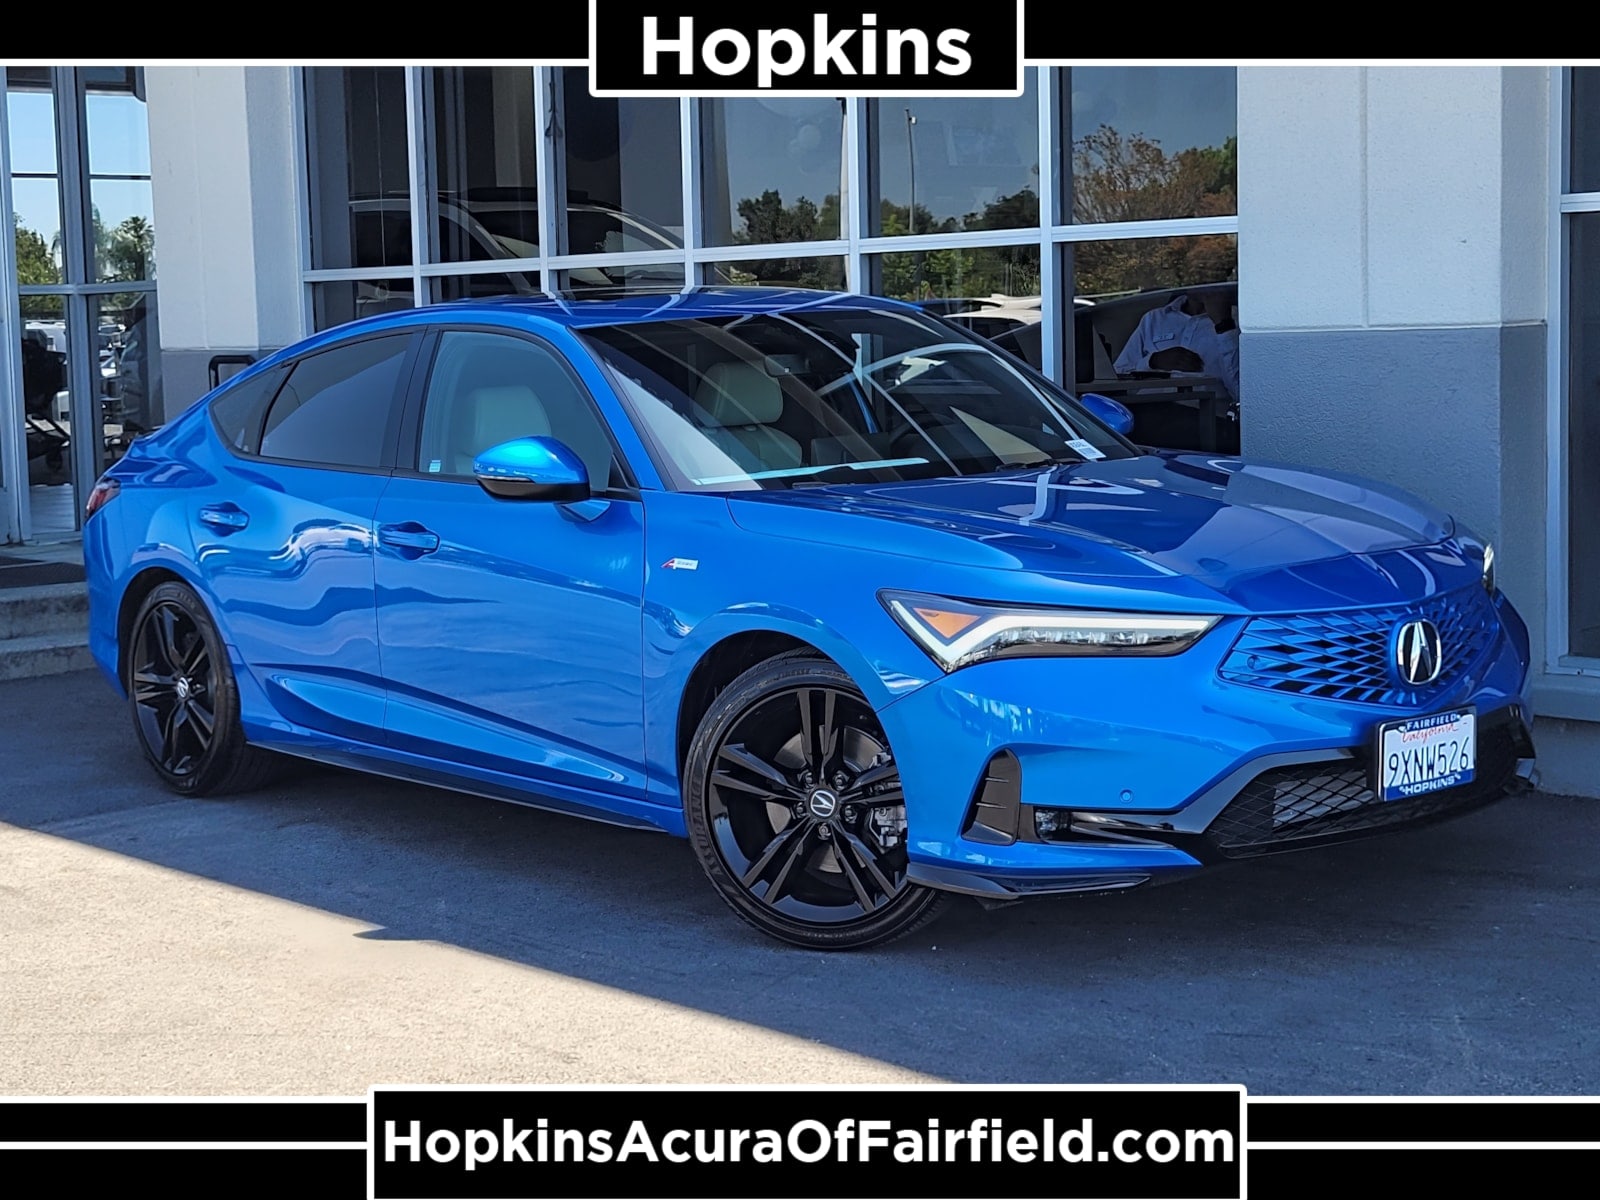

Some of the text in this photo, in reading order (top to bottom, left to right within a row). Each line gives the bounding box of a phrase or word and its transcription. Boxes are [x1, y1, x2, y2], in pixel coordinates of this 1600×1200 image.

[1406, 713, 1457, 731] FAIRFIELD
[1388, 736, 1470, 788] 9XNW526
[1404, 775, 1455, 795] HOPKINS
[691, 776, 724, 876] ASSURANCE
